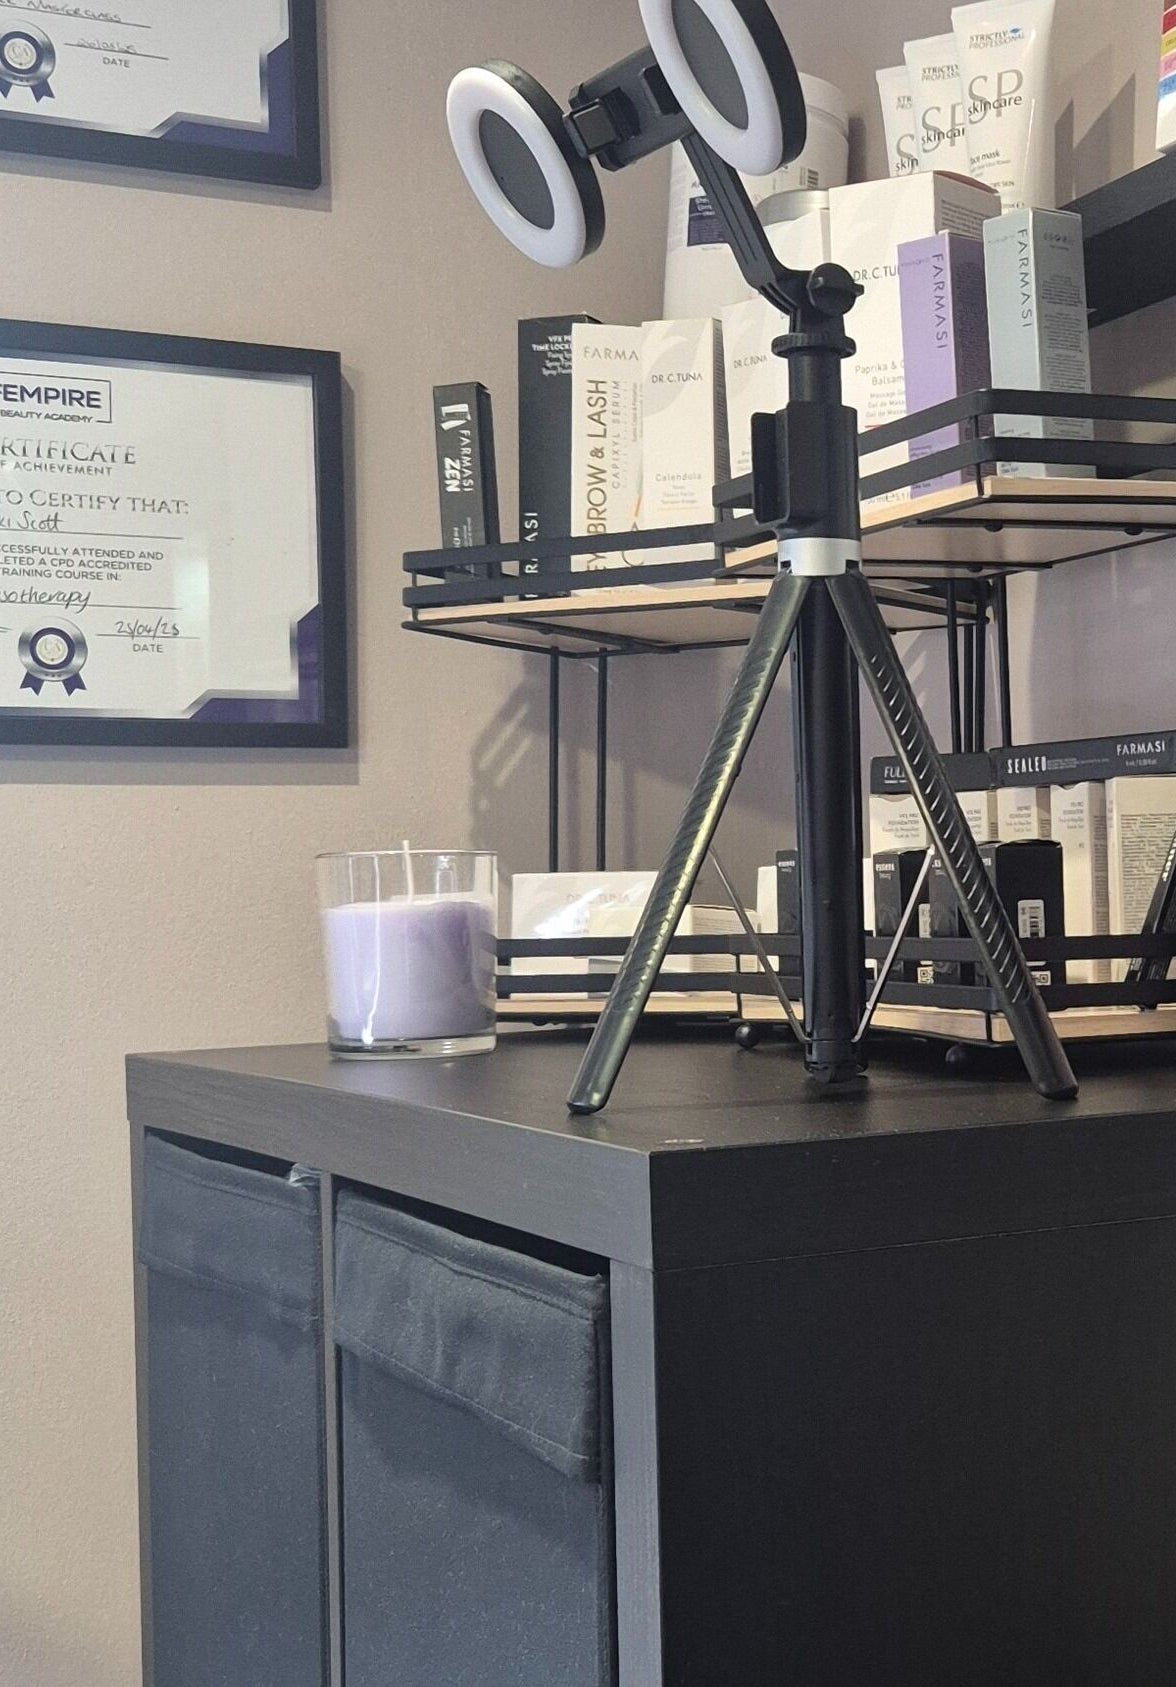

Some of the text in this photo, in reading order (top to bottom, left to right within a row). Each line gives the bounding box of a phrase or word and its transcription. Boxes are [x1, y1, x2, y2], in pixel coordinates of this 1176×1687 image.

[103, 56, 130, 68] DATE
[967, 95, 1023, 117] skincare
[968, 69, 1023, 125] SP
[1017, 228, 1032, 328] FARMASI
[932, 253, 949, 349] FARMASI
[855, 360, 888, 375] Paprika
[0, 383, 102, 409] EMPIRE
[612, 380, 621, 424] SERUM
[1, 409, 94, 424] BEAUTY ACADEMY
[587, 379, 607, 438] LASH
[13, 462, 113, 475] ACHIEVEMENT
[458, 429, 475, 492] FARMASI
[443, 456, 462, 493] ZEN
[655, 472, 702, 482] Calendula
[29, 488, 120, 511] CERTIFY
[126, 496, 189, 515] THAT:
[72, 547, 135, 560] ATTENDED
[138, 551, 164, 561] AND
[0, 567, 52, 578] RAINING
[55, 570, 103, 581] COURSE
[38, 558, 47, 567] A
[50, 558, 75, 568] CPD
[78, 560, 153, 571] ACCREDITED
[132, 643, 165, 654] DATE
[1116, 740, 1166, 757] FARMASI
[1007, 755, 1047, 774] SEALED
